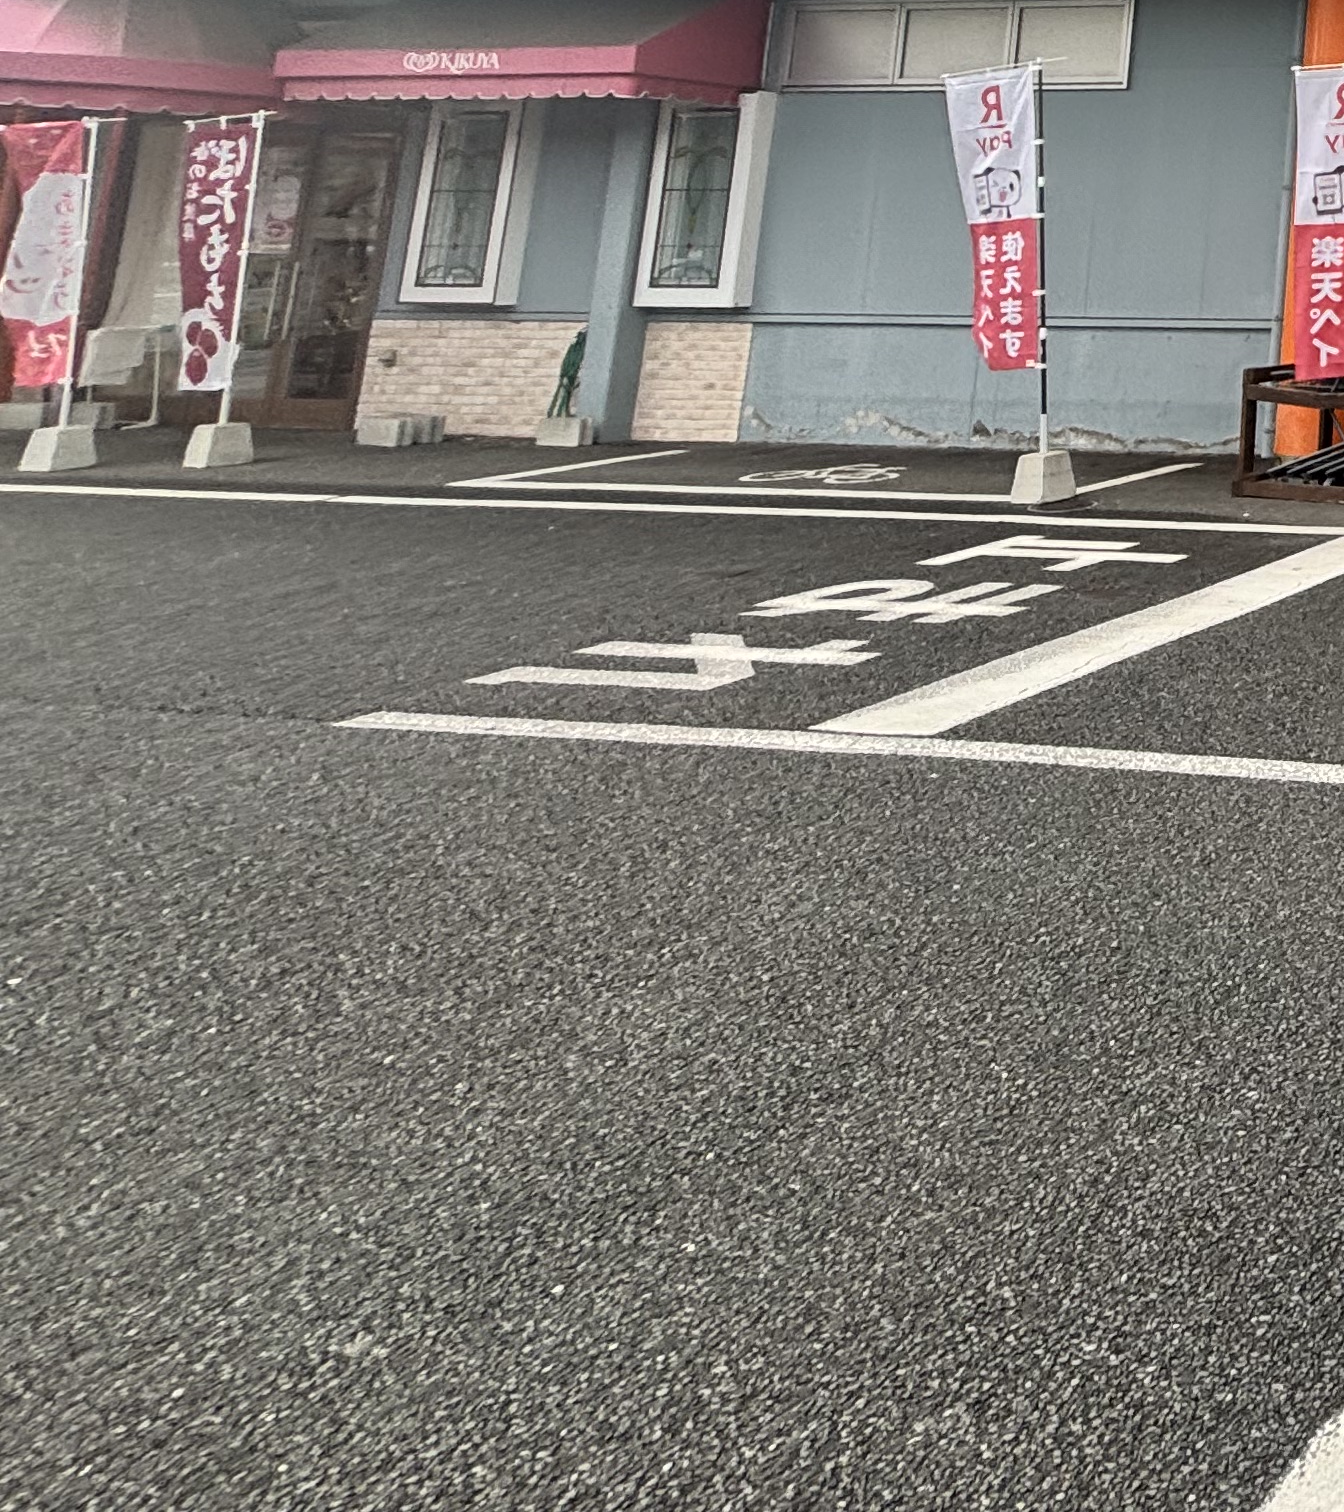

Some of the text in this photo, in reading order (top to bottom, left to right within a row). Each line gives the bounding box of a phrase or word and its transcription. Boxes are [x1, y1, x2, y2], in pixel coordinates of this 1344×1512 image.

[440, 51, 500, 75] KIKUYA
[465, 533, 1189, 692] 止まれ
